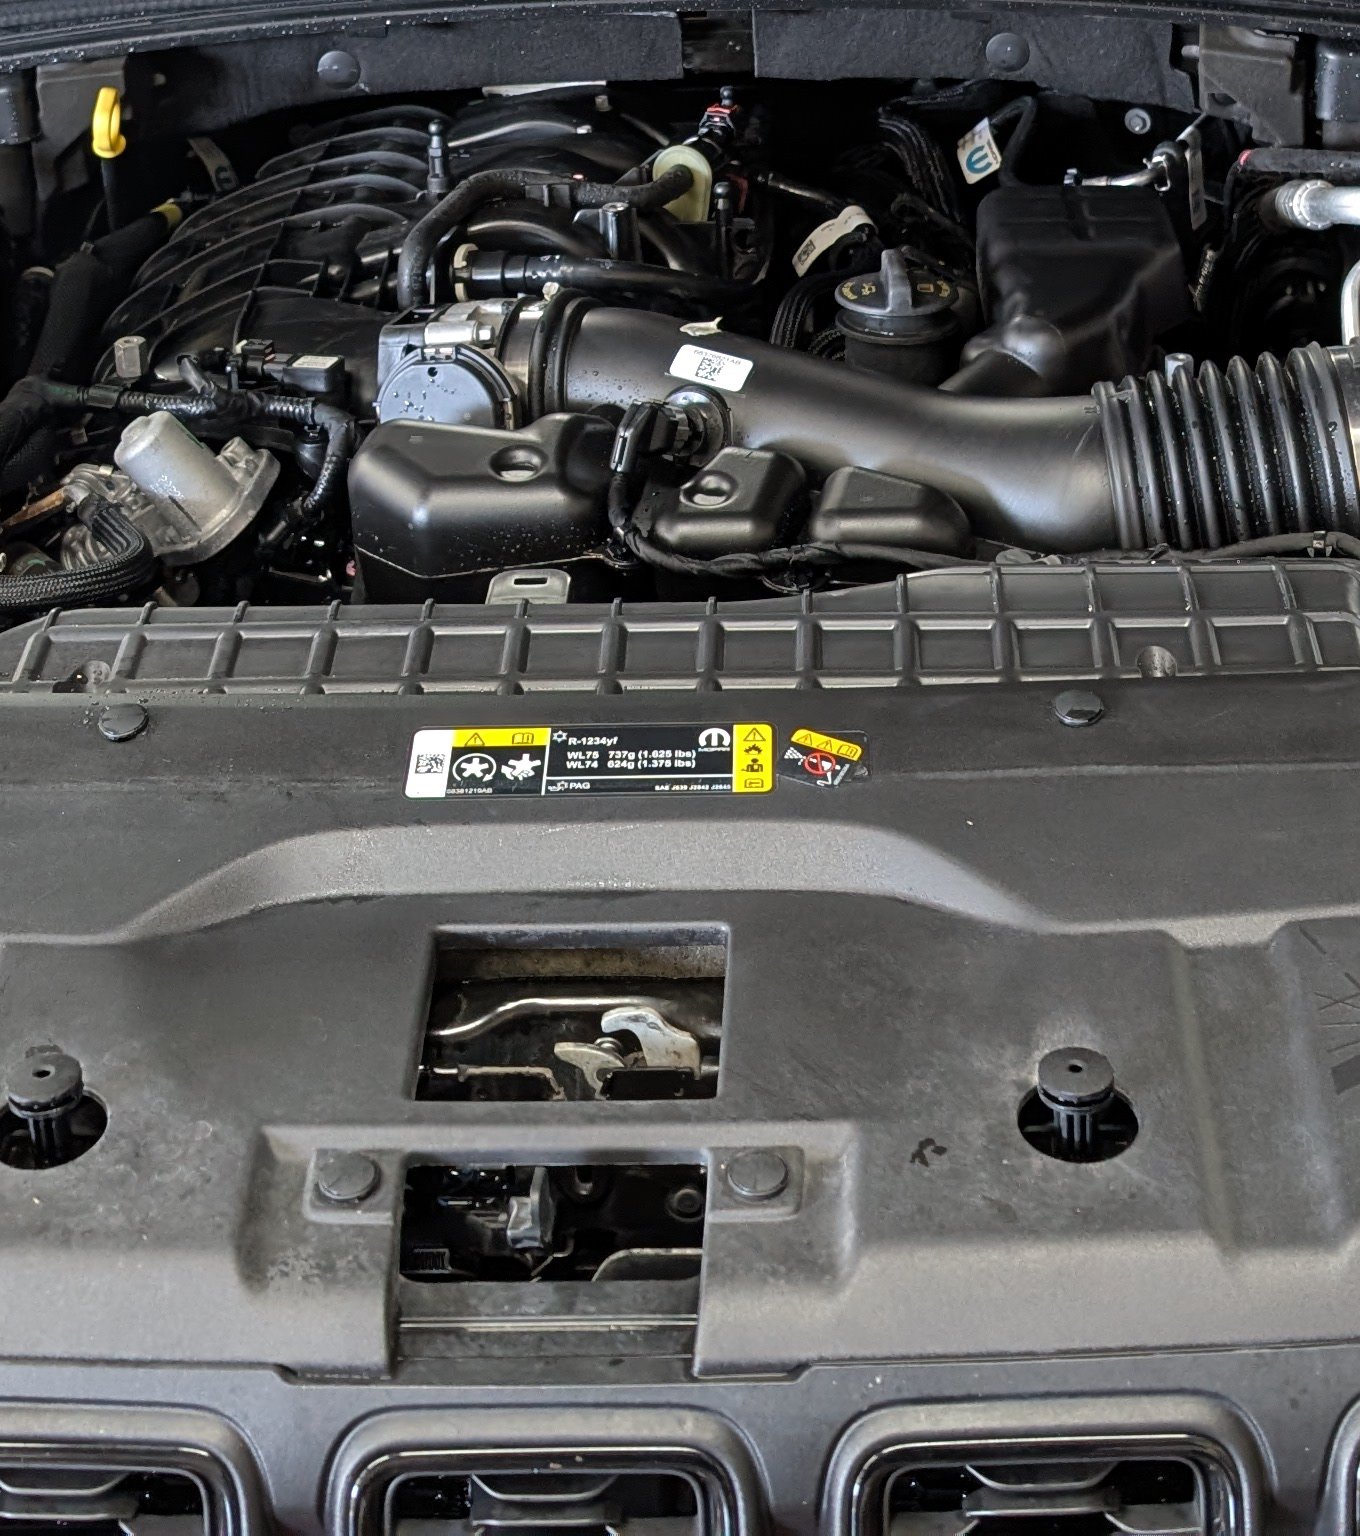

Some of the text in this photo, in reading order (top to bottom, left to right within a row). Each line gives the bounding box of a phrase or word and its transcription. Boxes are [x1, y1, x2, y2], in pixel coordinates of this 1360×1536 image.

[567, 736, 618, 747] R-1234yf
[567, 750, 600, 760] WL75
[608, 750, 636, 760] 737g
[674, 750, 697, 759] lbs)
[566, 759, 696, 769] WL74 624g (1.375 lbs)
[569, 781, 591, 790] PAG
